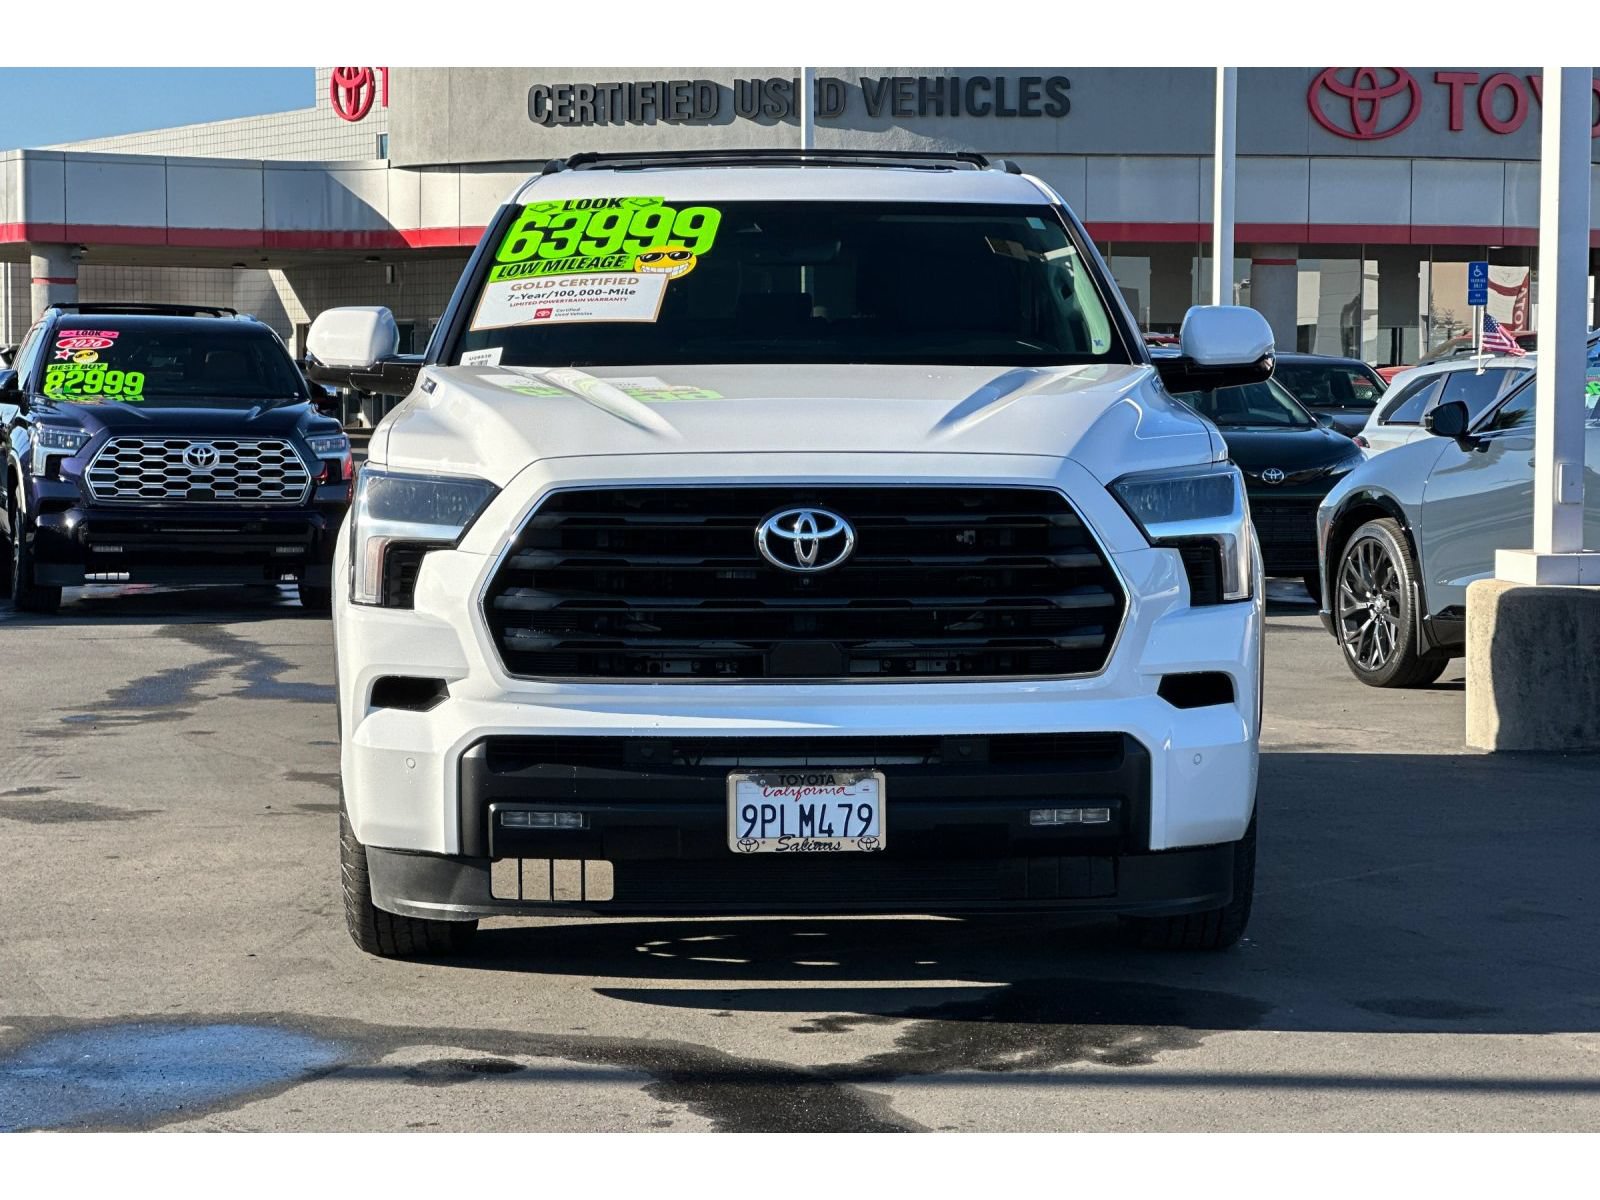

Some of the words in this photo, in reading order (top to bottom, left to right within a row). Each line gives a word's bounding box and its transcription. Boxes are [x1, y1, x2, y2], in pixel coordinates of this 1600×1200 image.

[528, 80, 719, 124] CERTIFIED
[860, 76, 1071, 117] VEHICLES
[563, 197, 625, 211] LOOK
[496, 207, 722, 263] 63999
[497, 262, 541, 279] LOW
[541, 255, 626, 273] MILEAGE
[510, 280, 556, 292] GOLD
[558, 277, 640, 289] CERTIFIED
[507, 289, 636, 302] 7-Year/100,000-Mile
[509, 300, 538, 308] LIMITED
[68, 339, 105, 349] 2026
[44, 370, 145, 397] 82999
[779, 774, 836, 786] TOYOTA
[742, 803, 873, 839] 9PLM479
[776, 835, 842, 852] Salinas
